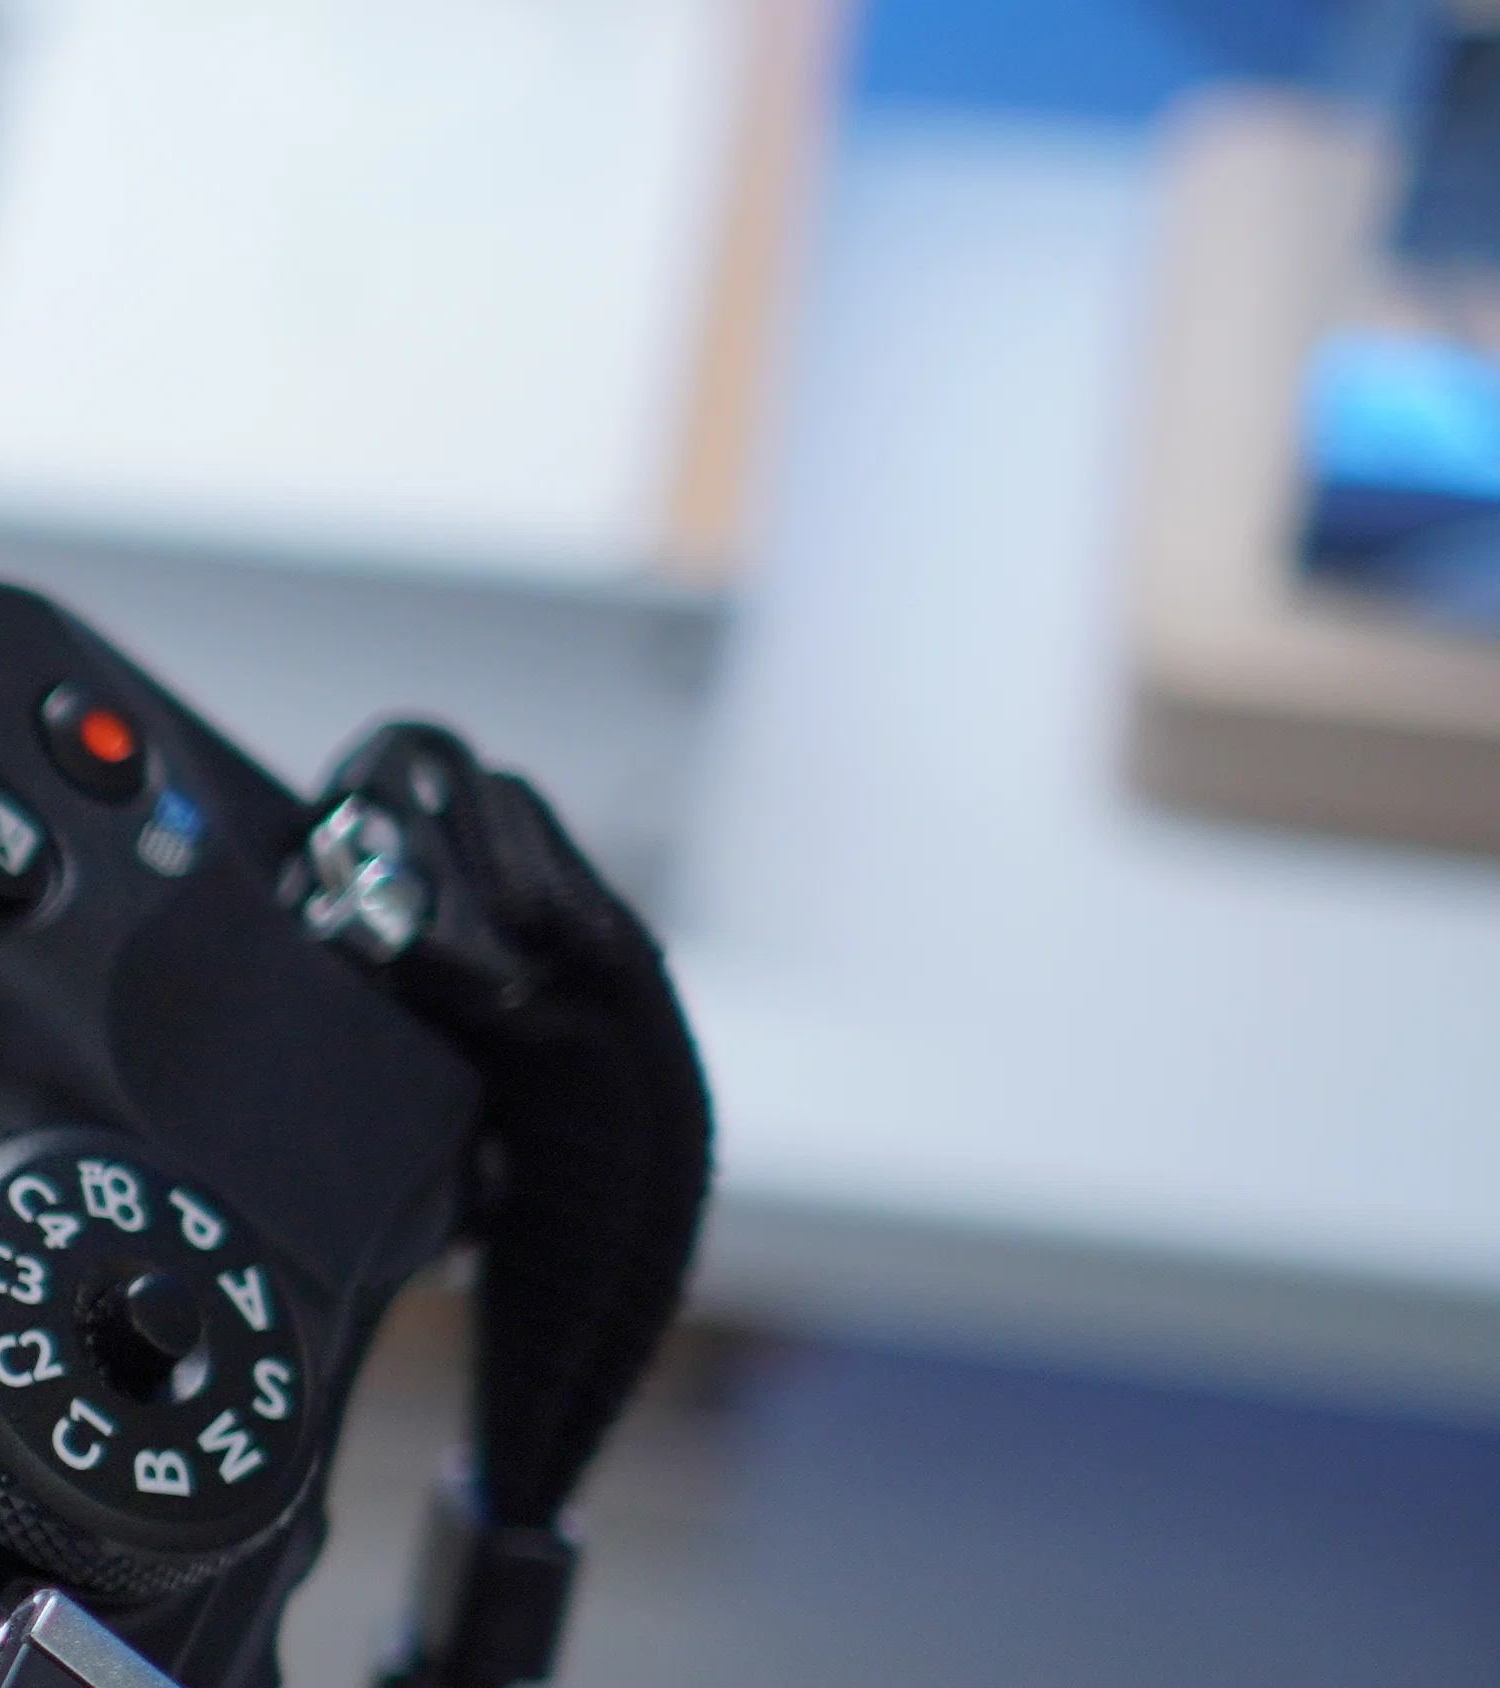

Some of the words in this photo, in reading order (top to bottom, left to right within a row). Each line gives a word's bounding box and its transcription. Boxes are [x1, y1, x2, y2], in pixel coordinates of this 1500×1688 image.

[8, 1173, 81, 1250] C4
[168, 1187, 225, 1250] P
[216, 1266, 270, 1331] A
[252, 1358, 292, 1421] S
[52, 1397, 115, 1471] C1
[197, 1408, 264, 1485] M
[133, 1449, 191, 1497] B
